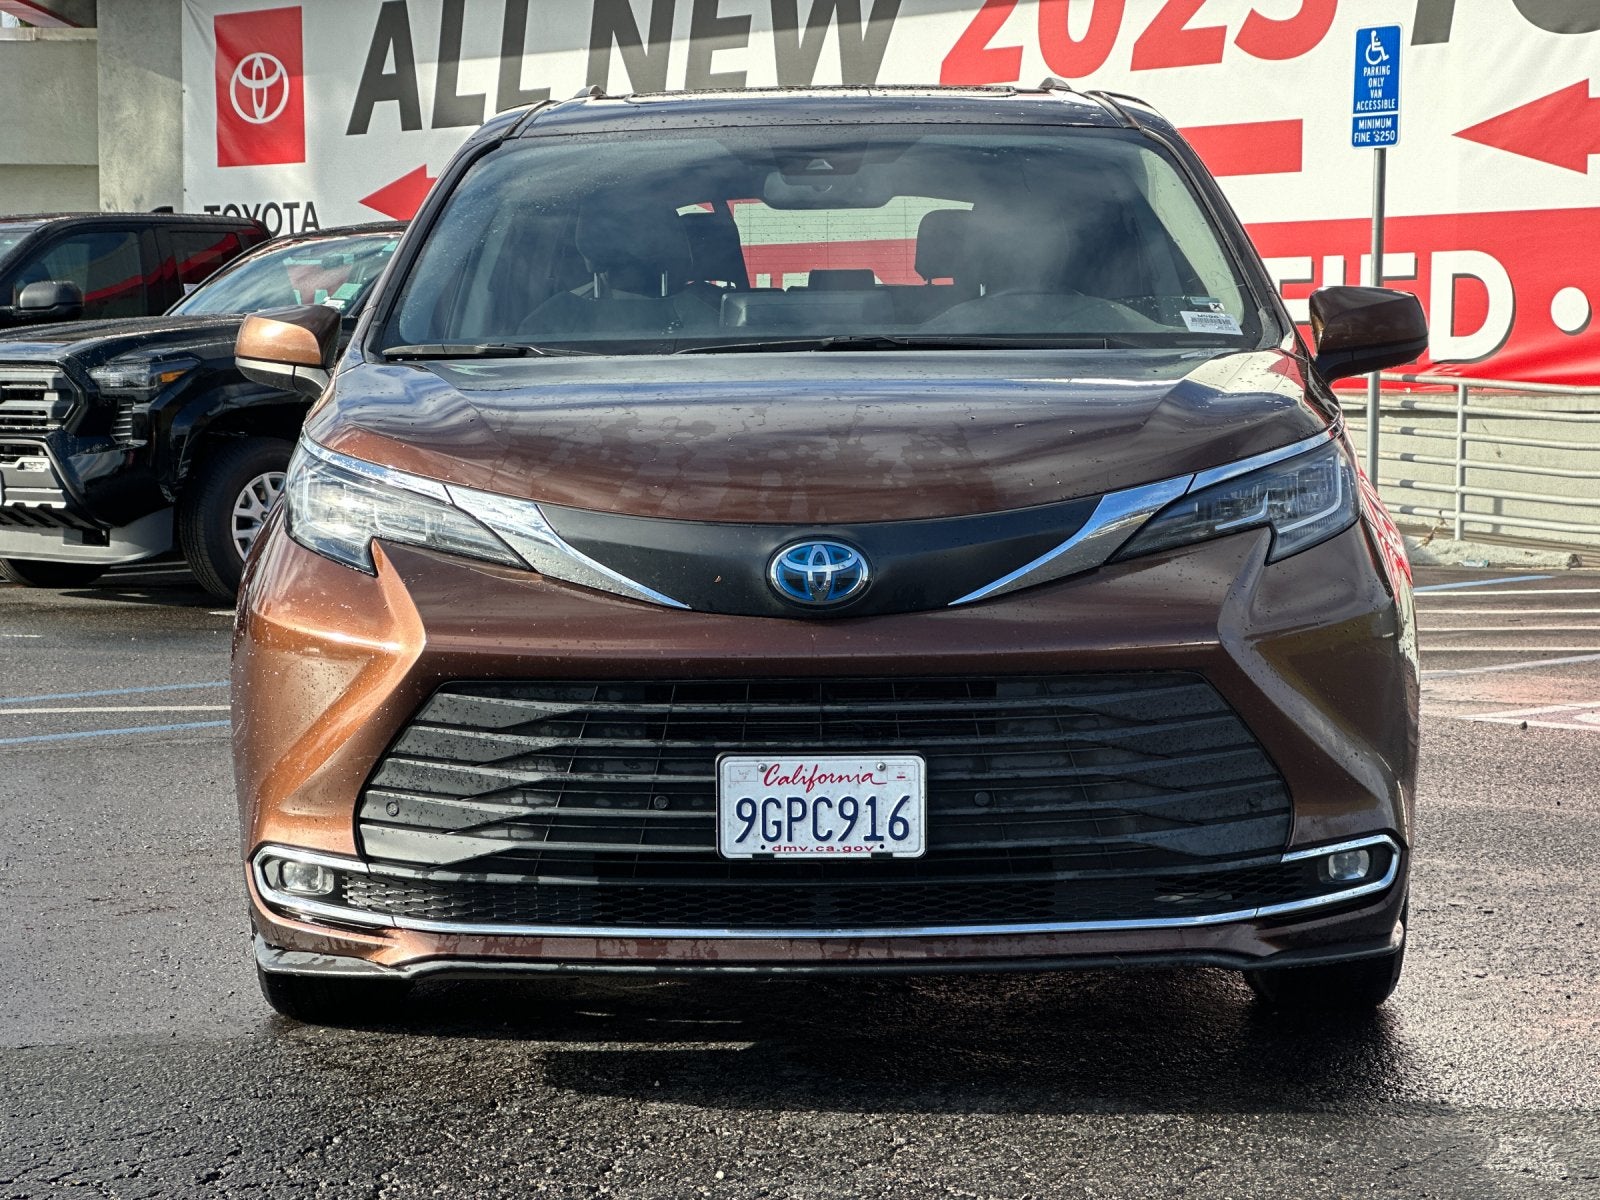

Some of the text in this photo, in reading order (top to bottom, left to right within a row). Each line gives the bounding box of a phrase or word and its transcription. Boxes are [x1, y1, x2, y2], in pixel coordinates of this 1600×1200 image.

[346, 0, 553, 135] ALL
[585, 0, 901, 93] NEW
[1363, 65, 1391, 77] PARKING
[1368, 77, 1385, 88] ONLY
[1370, 88, 1382, 99] VAN
[1356, 98, 1396, 111] ACCESSIBLE
[1358, 118, 1392, 130] MINIMUM
[1354, 132, 1371, 143] FINE
[763, 763, 887, 793] California
[735, 795, 910, 843] 9GPC916
[771, 844, 875, 853] dmv.ca.gov
